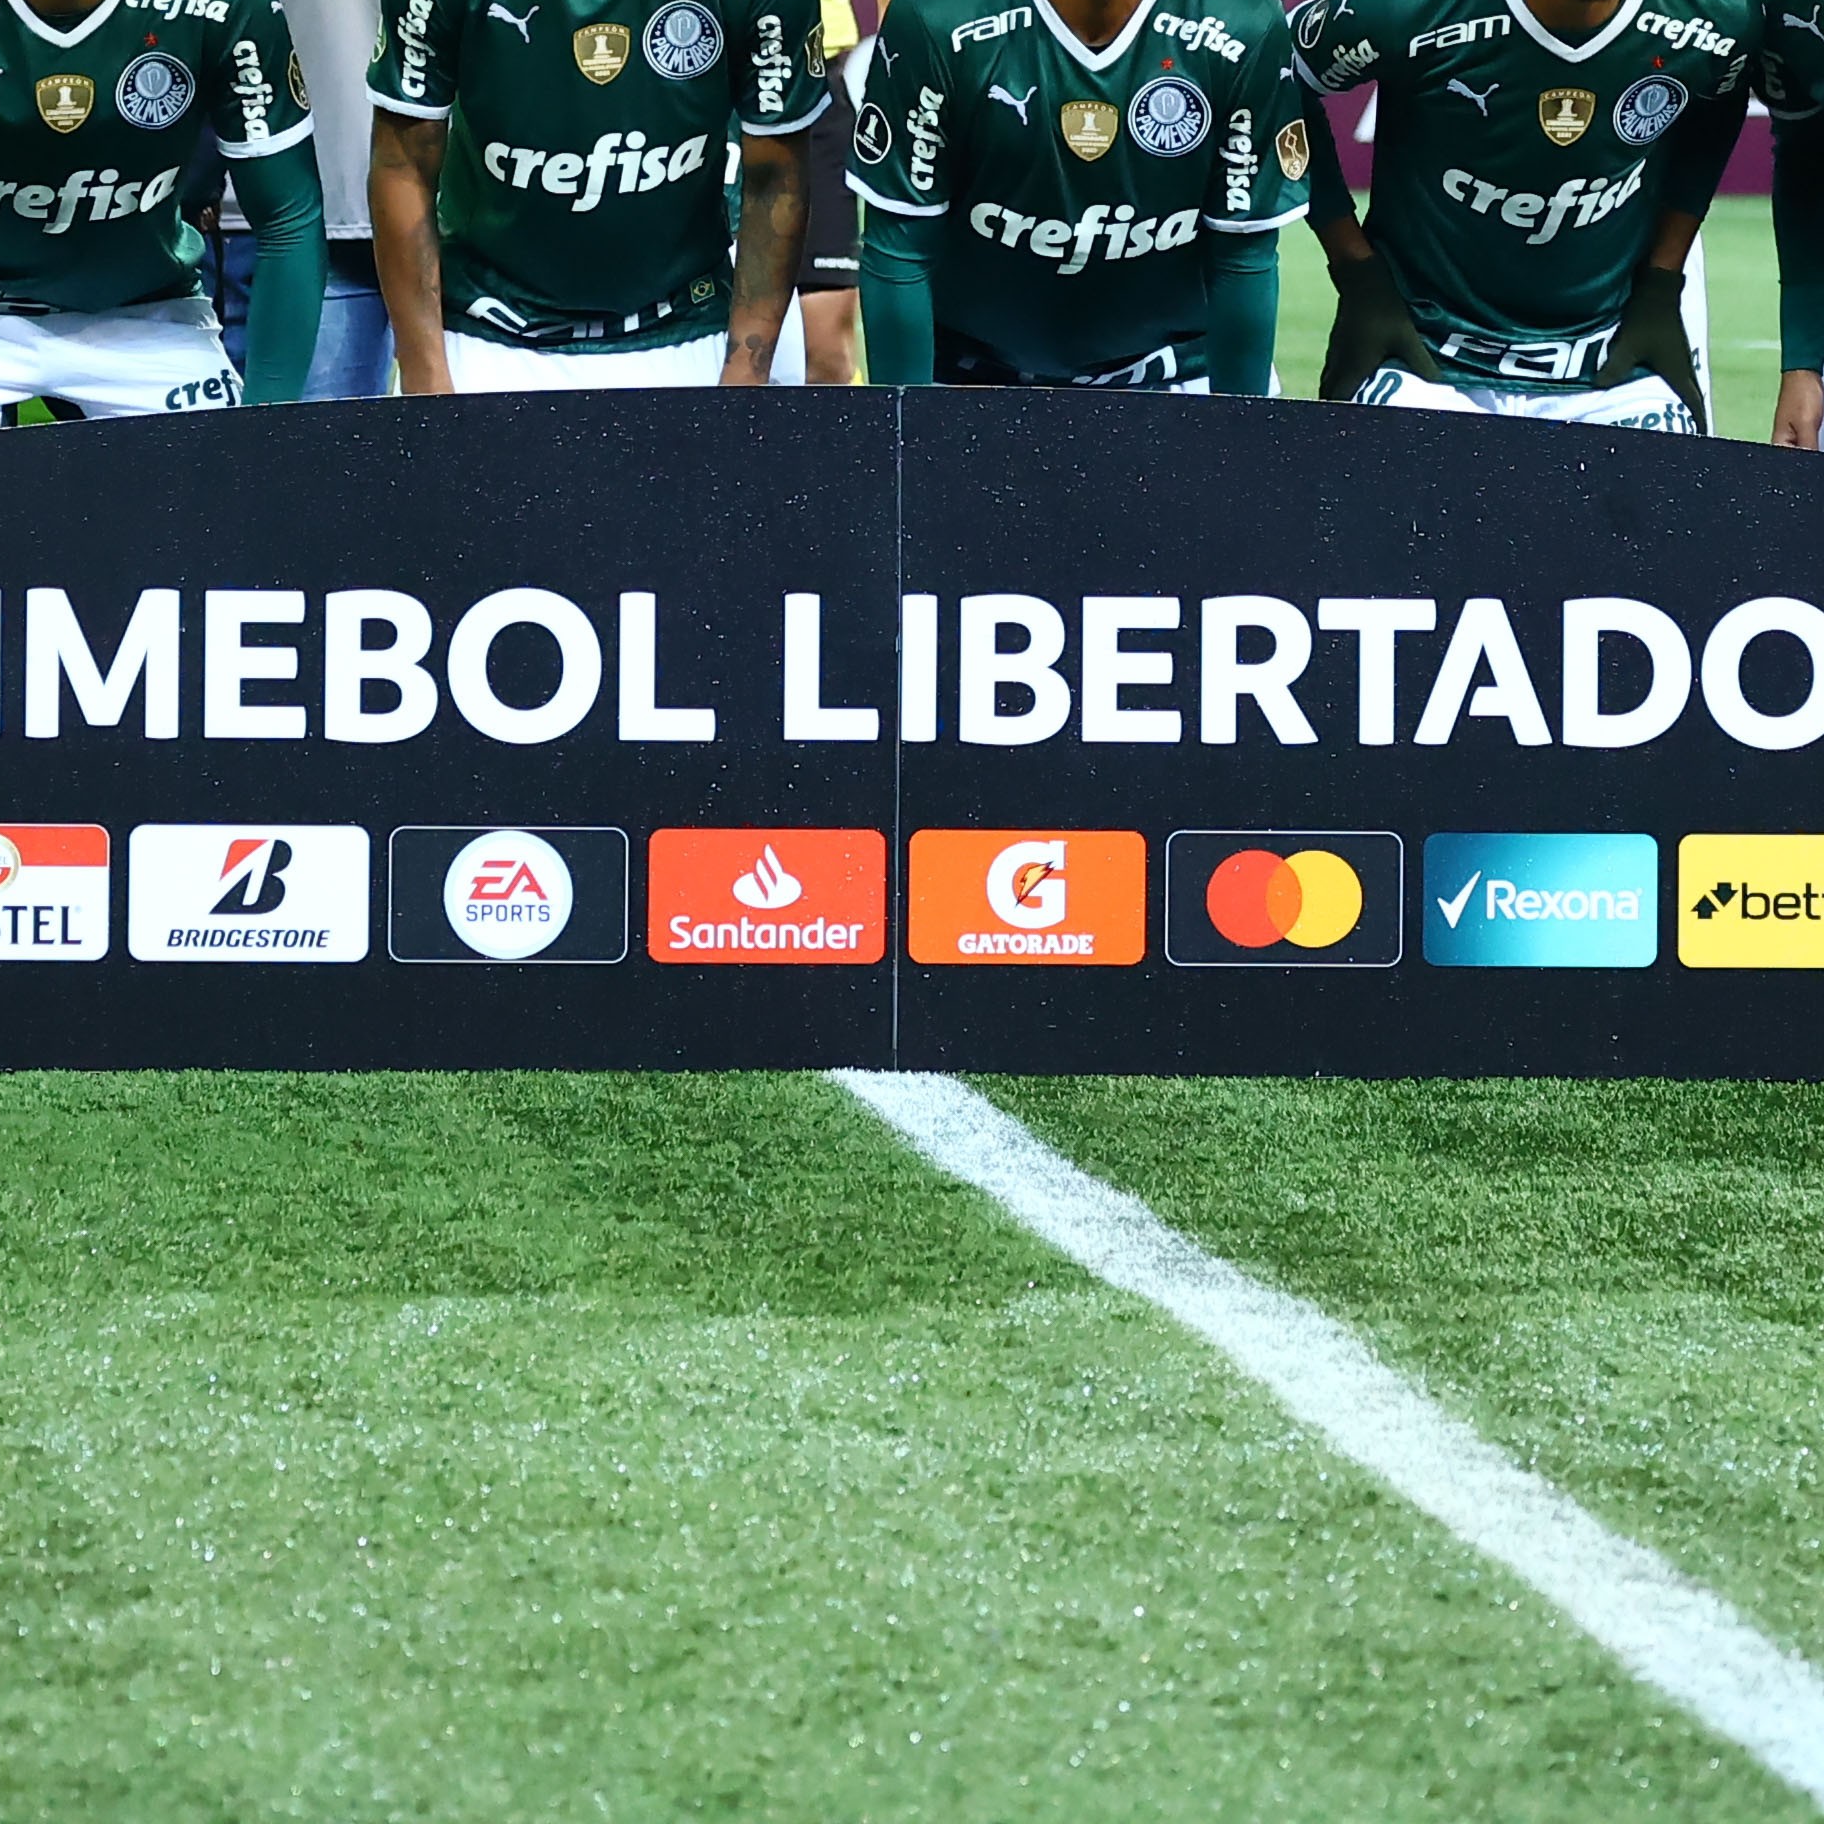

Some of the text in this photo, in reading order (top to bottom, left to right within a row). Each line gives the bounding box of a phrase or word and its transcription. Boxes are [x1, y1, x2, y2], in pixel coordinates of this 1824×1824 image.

[651, 35, 716, 73] PALMEIRAS
[1153, 11, 1246, 64] crefisa
[1636, 10, 1736, 57] crefisa
[751, 14, 793, 114] crefisa
[127, 83, 187, 124] PALMEIRAS
[233, 39, 271, 143] crefisa
[908, 85, 944, 191] crefisa
[1133, 111, 1198, 150] PALMEIRAS
[1621, 102, 1679, 140] PALMEIRAS
[484, 131, 709, 212] crefisa
[1222, 108, 1258, 212] crefisa
[1442, 158, 1647, 245] crefisa
[970, 202, 1199, 275] crefisa
[165, 368, 237, 411] cref
[467, 860, 549, 901] EA
[986, 839, 1067, 930] G
[1486, 878, 1640, 921] Rexona
[465, 904, 551, 923] SPORTS
[669, 916, 865, 950] Santander
[166, 928, 331, 949] BRIDGESTONE
[957, 933, 1094, 956] GATORADE
